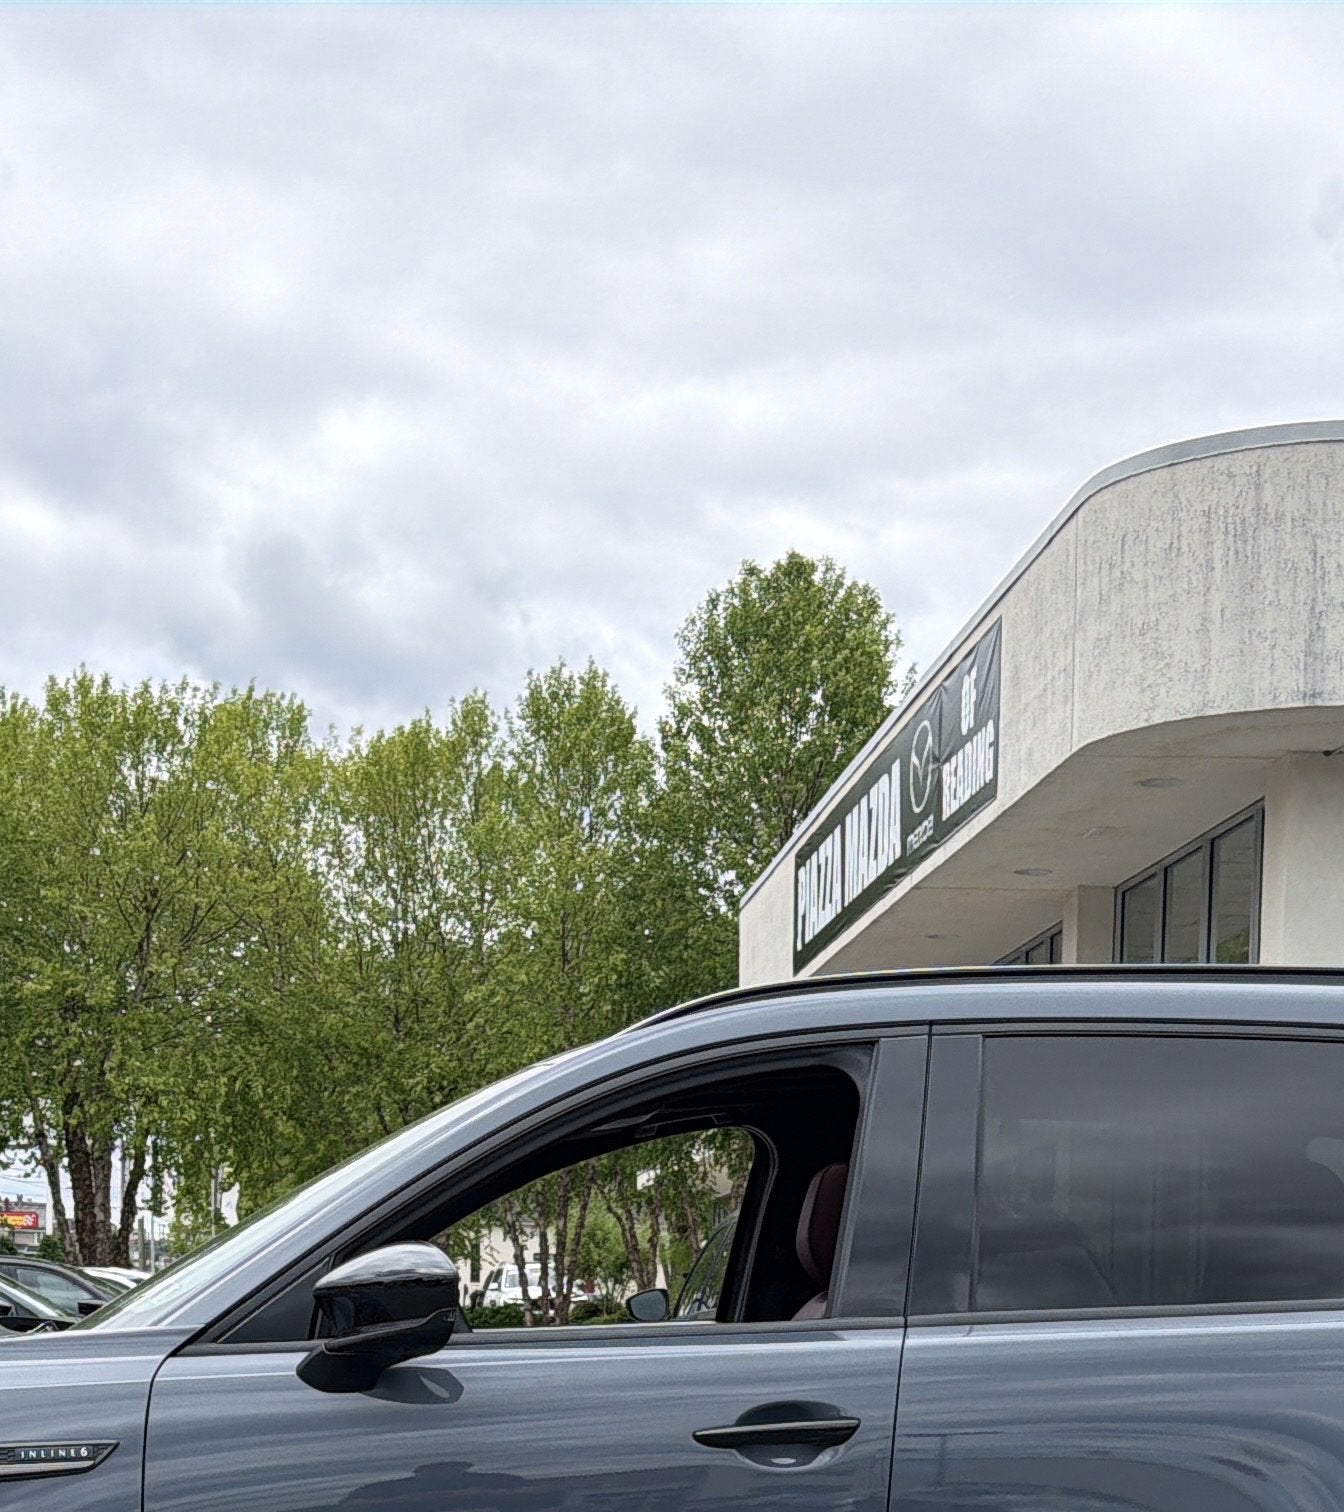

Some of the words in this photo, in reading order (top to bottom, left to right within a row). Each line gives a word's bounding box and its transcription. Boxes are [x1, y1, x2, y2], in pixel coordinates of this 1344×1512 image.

[961, 665, 977, 736] OF
[942, 719, 995, 822] READING
[797, 823, 843, 951] PIAZZA
[844, 758, 902, 907] MAZDA
